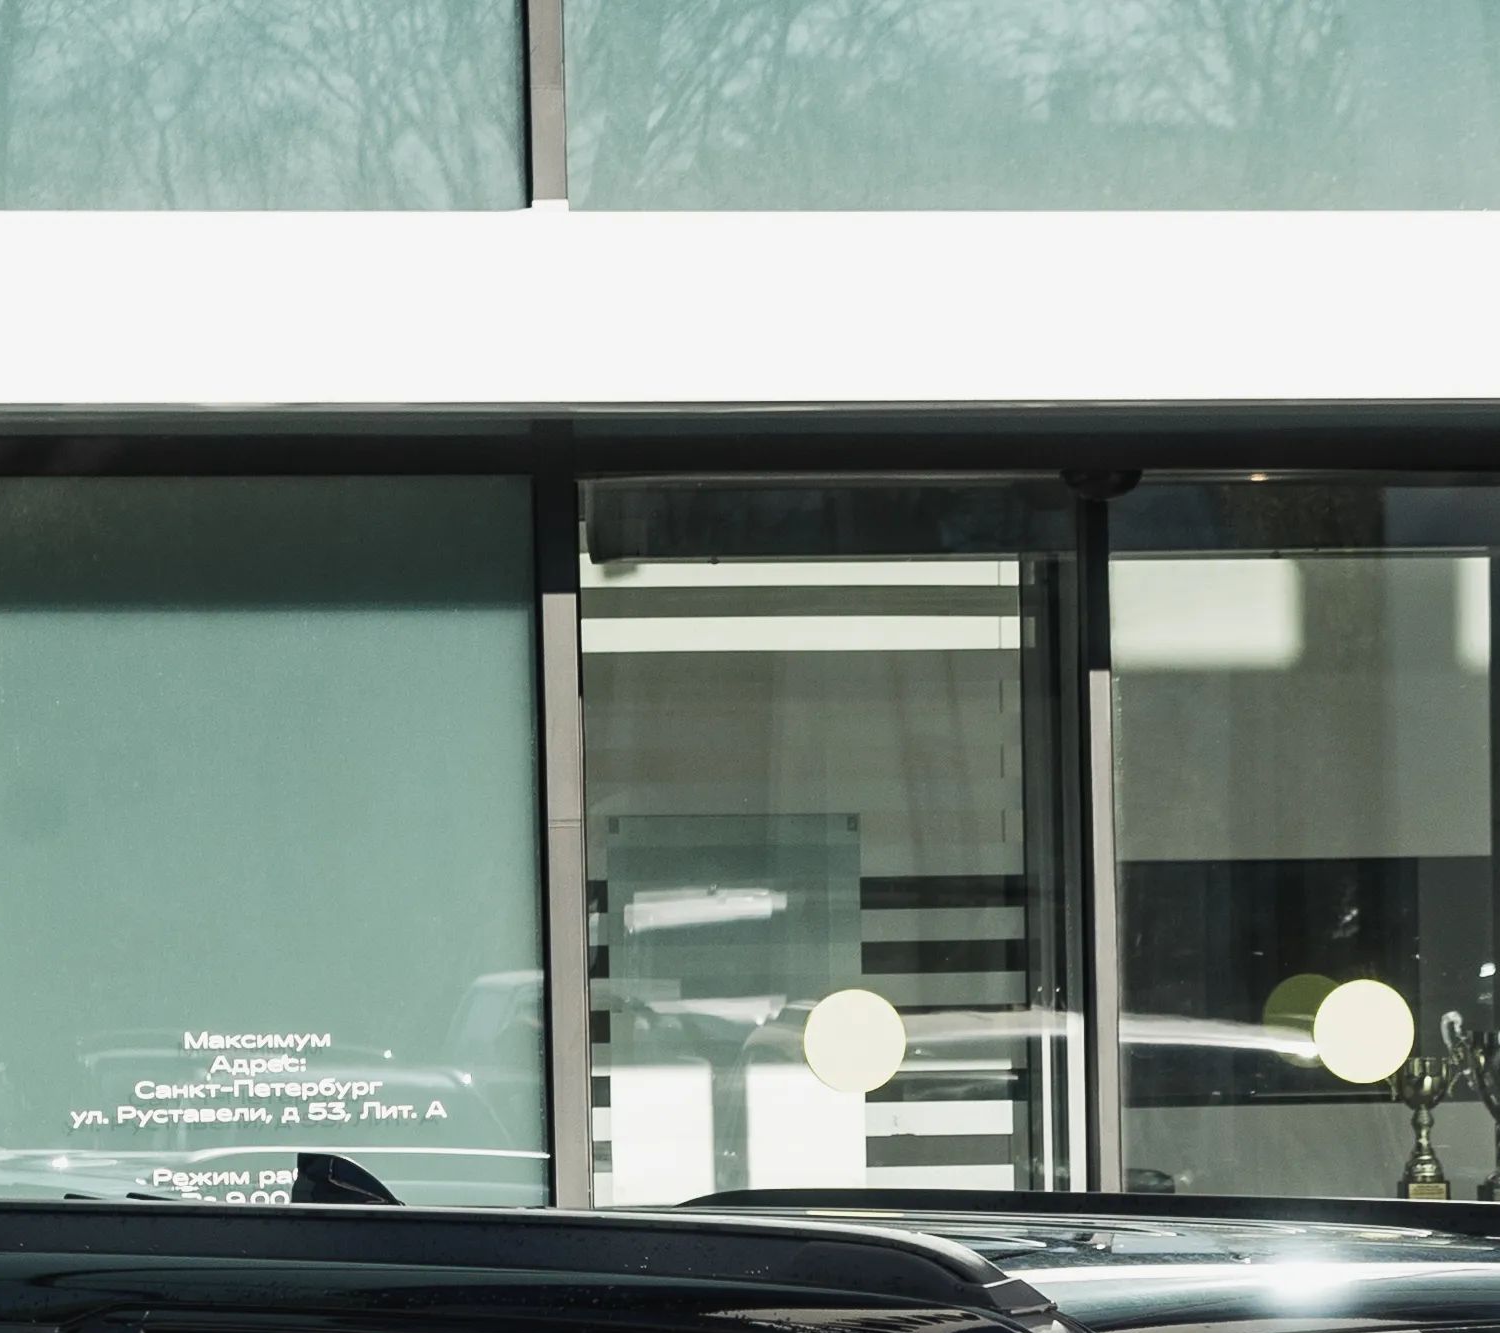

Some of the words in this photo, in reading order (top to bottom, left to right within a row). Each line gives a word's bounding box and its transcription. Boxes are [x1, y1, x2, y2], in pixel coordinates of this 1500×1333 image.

[183, 1030, 331, 1051] Максимум
[210, 1055, 307, 1077] Адрес:
[134, 1079, 383, 1101] Санкт-Петербург
[70, 1110, 109, 1129] ул.
[117, 1104, 273, 1126] Руставели,
[308, 1102, 351, 1123] 53,
[360, 1101, 418, 1121] Лит.
[425, 1100, 448, 1120] А
[153, 1168, 250, 1187] Режим
